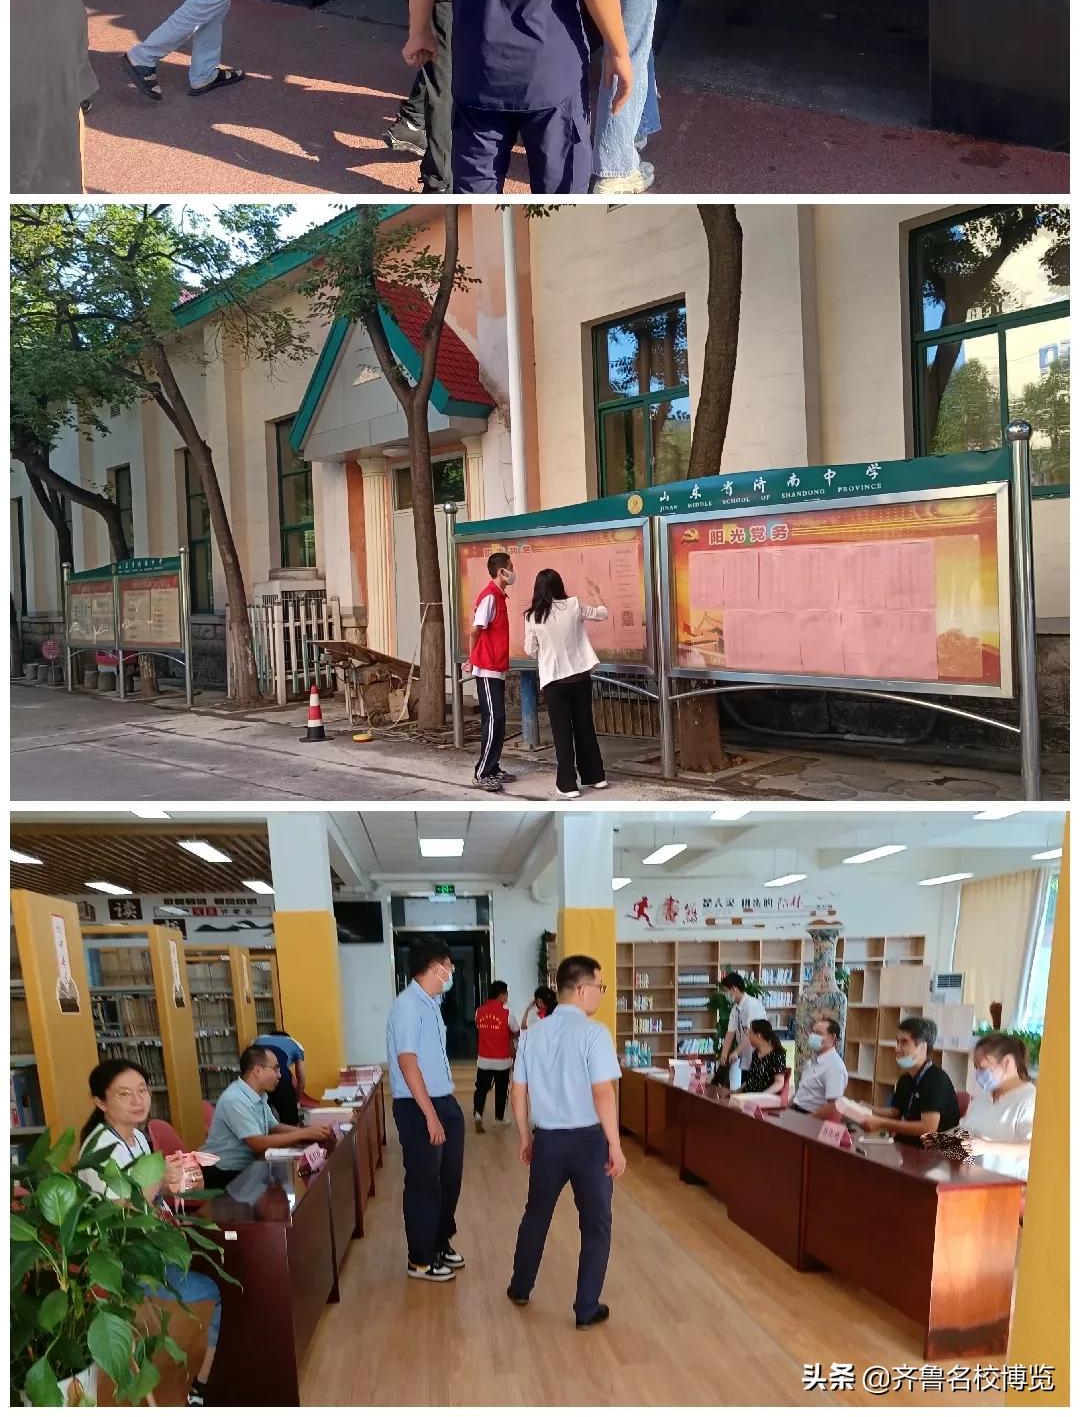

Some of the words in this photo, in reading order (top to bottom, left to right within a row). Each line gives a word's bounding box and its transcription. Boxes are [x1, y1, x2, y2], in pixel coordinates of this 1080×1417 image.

[659, 504, 678, 513] JINAN
[687, 500, 713, 509] MIDDLE
[722, 496, 751, 505] SCHOOL
[781, 488, 826, 499] SHANDONG
[837, 483, 882, 494] PROVINCE
[709, 524, 789, 545] 阳光党务
